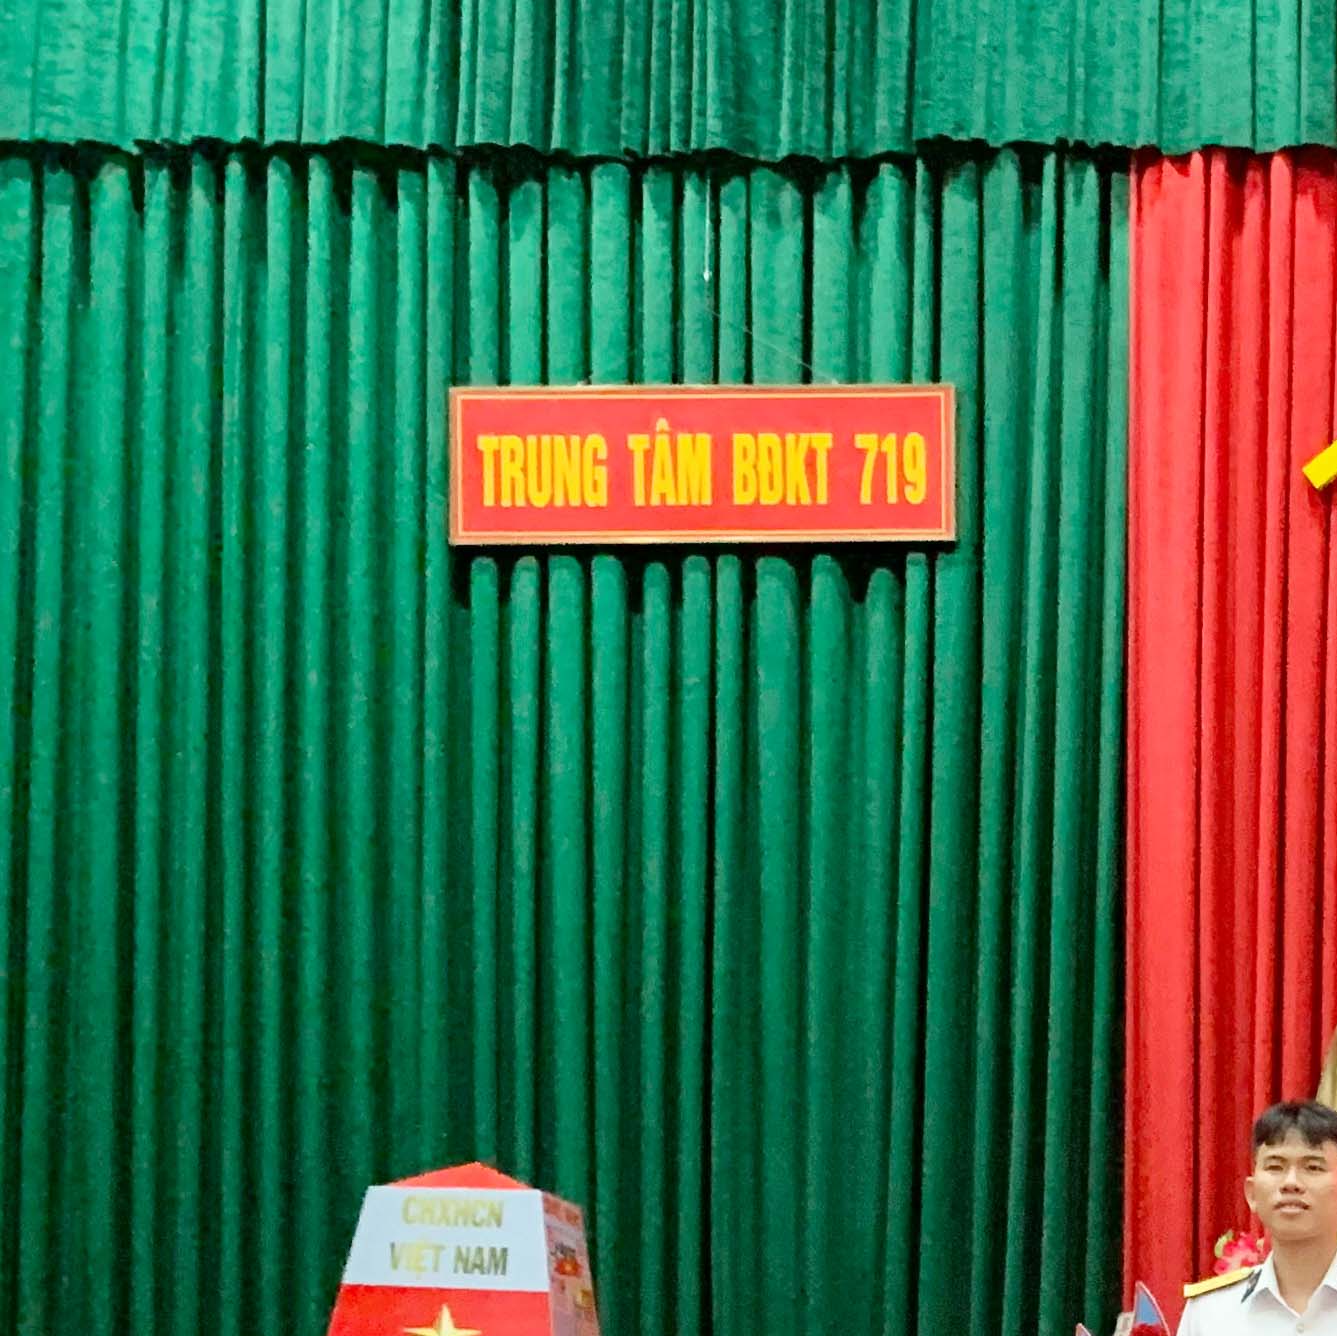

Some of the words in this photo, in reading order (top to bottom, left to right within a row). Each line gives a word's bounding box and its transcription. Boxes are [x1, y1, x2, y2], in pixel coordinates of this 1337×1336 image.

[477, 434, 608, 507] TRUNG
[627, 416, 712, 507] TÂM
[732, 432, 833, 506] BĐKT
[855, 431, 928, 505] 719
[402, 1194, 504, 1228] CHXHCN
[389, 1234, 446, 1280] VIỆT
[453, 1246, 509, 1276] NAM
